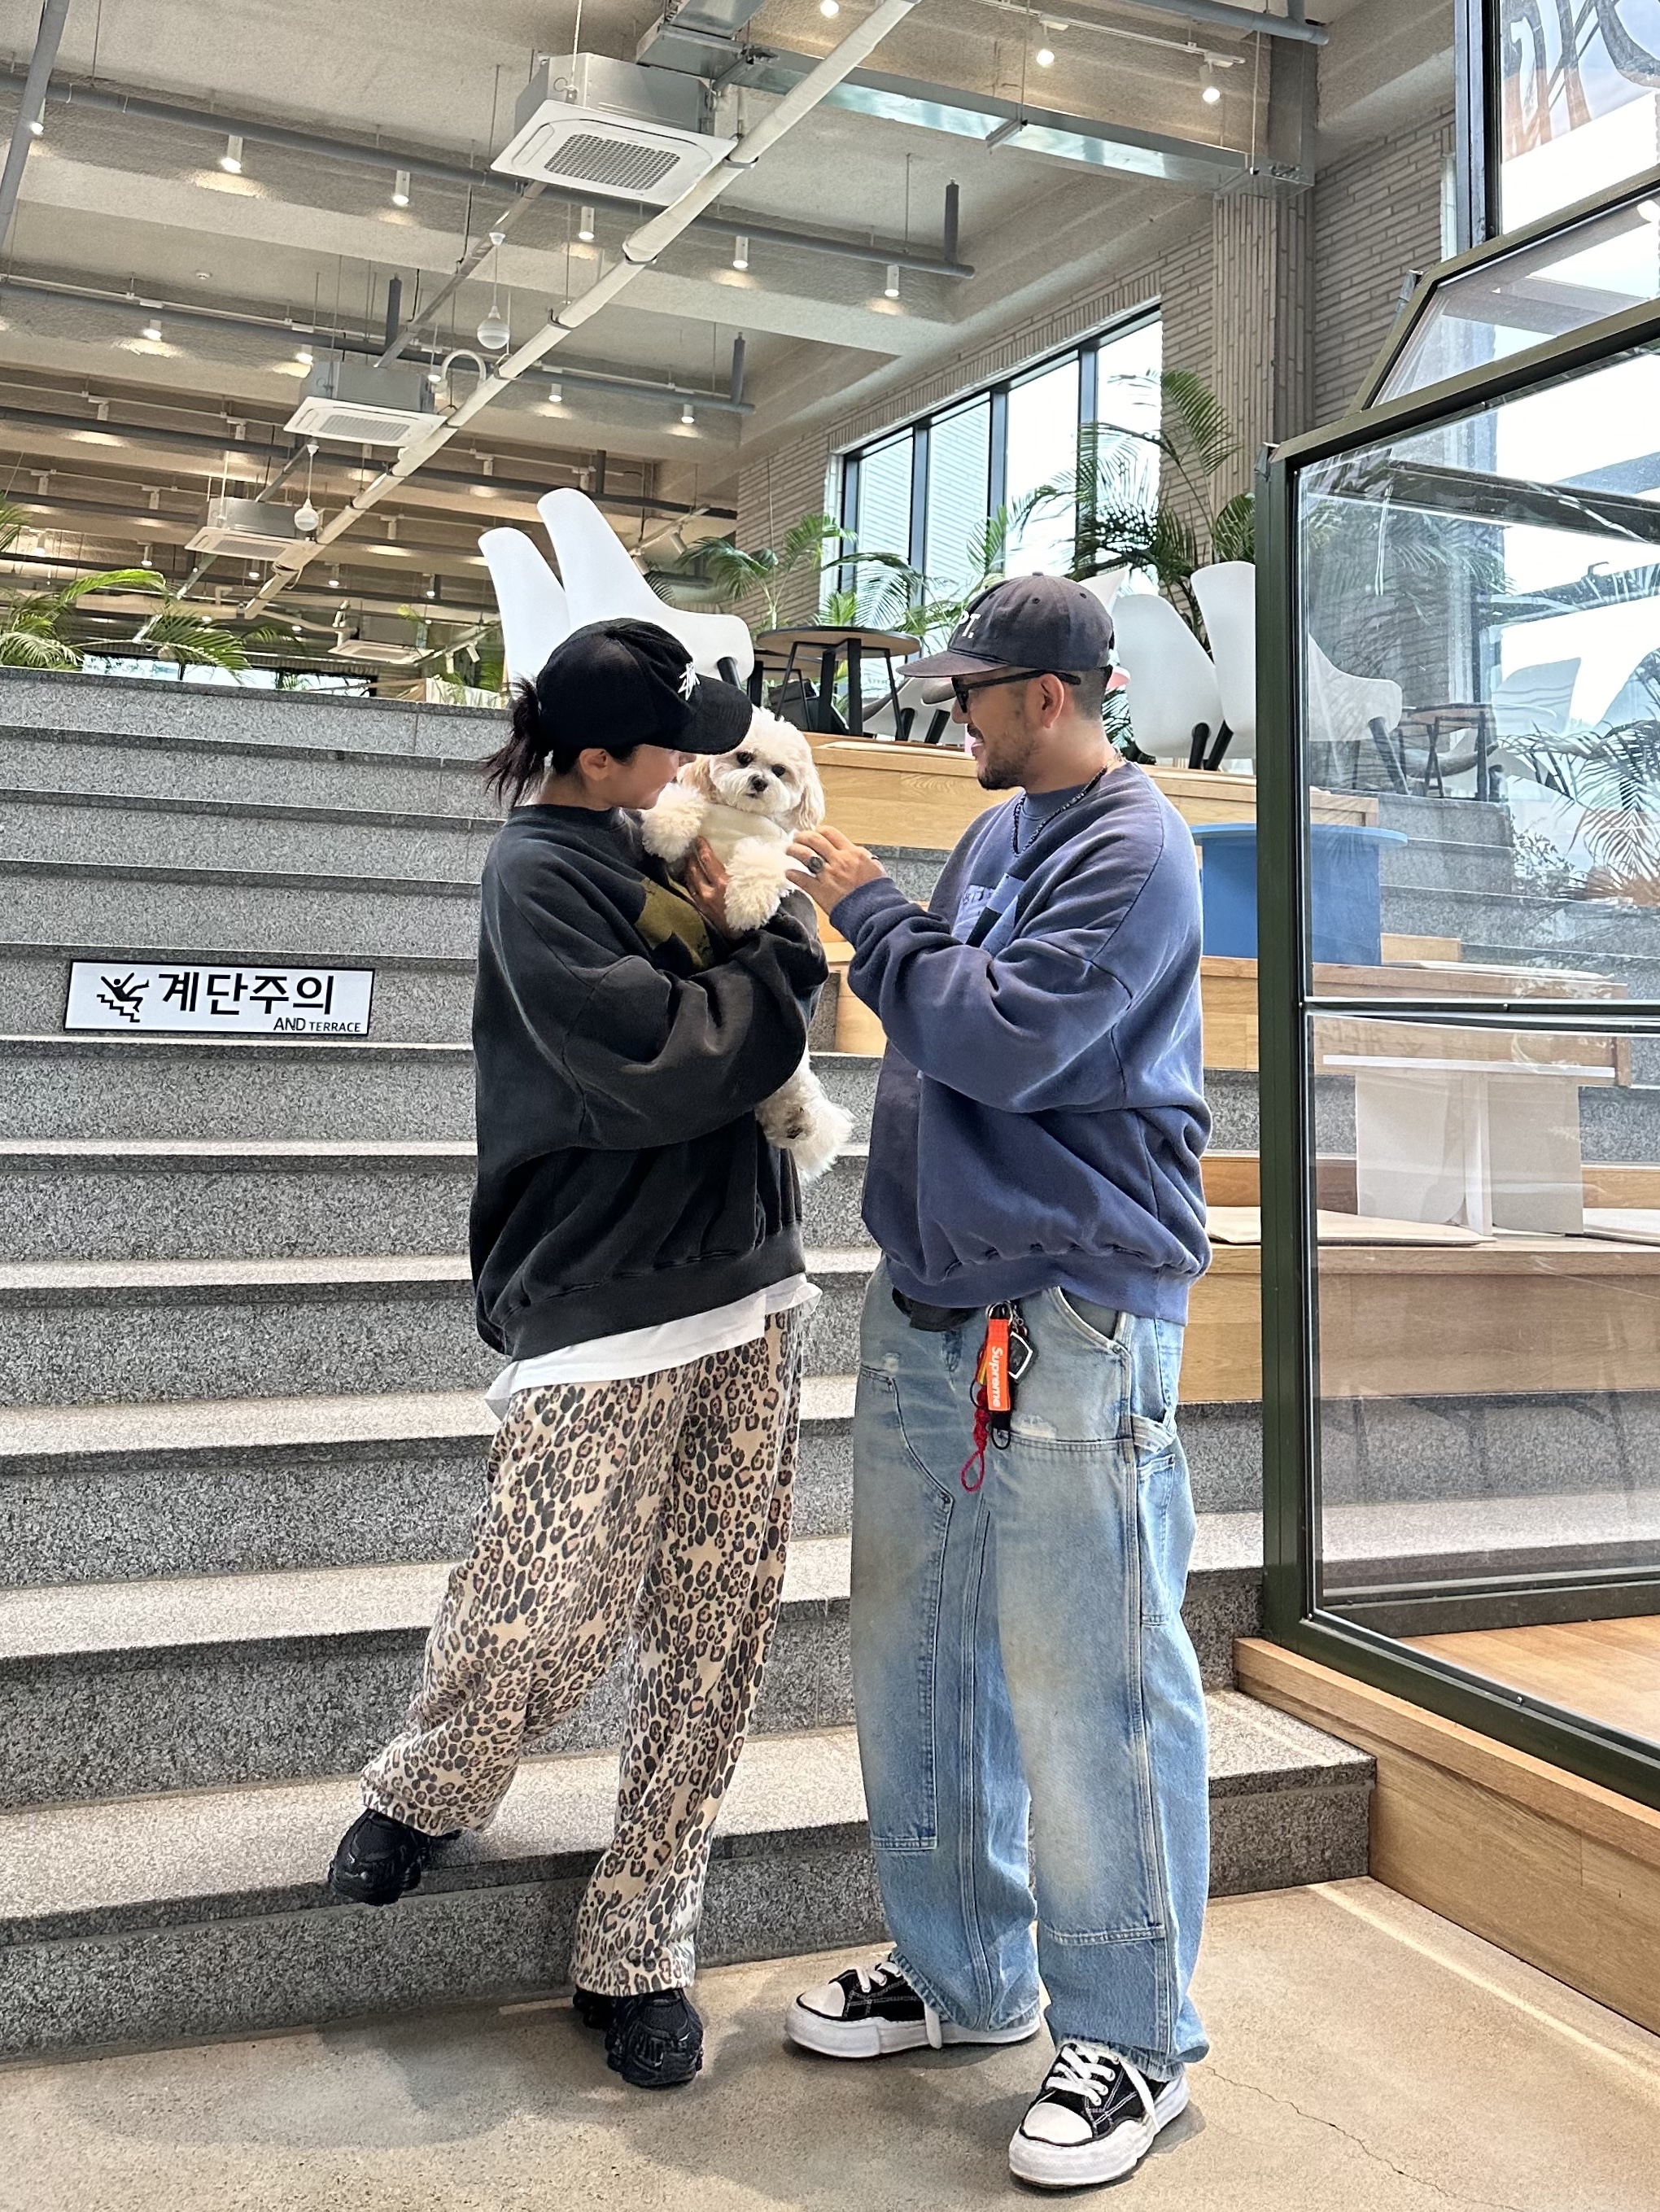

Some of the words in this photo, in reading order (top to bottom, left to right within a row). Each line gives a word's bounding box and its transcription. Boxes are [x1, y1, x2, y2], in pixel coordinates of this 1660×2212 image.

[158, 971, 334, 1016] 계단주의
[273, 1016, 306, 1031] AND
[308, 1021, 361, 1033] TERRACE
[988, 1345, 1003, 1408] Supreme
